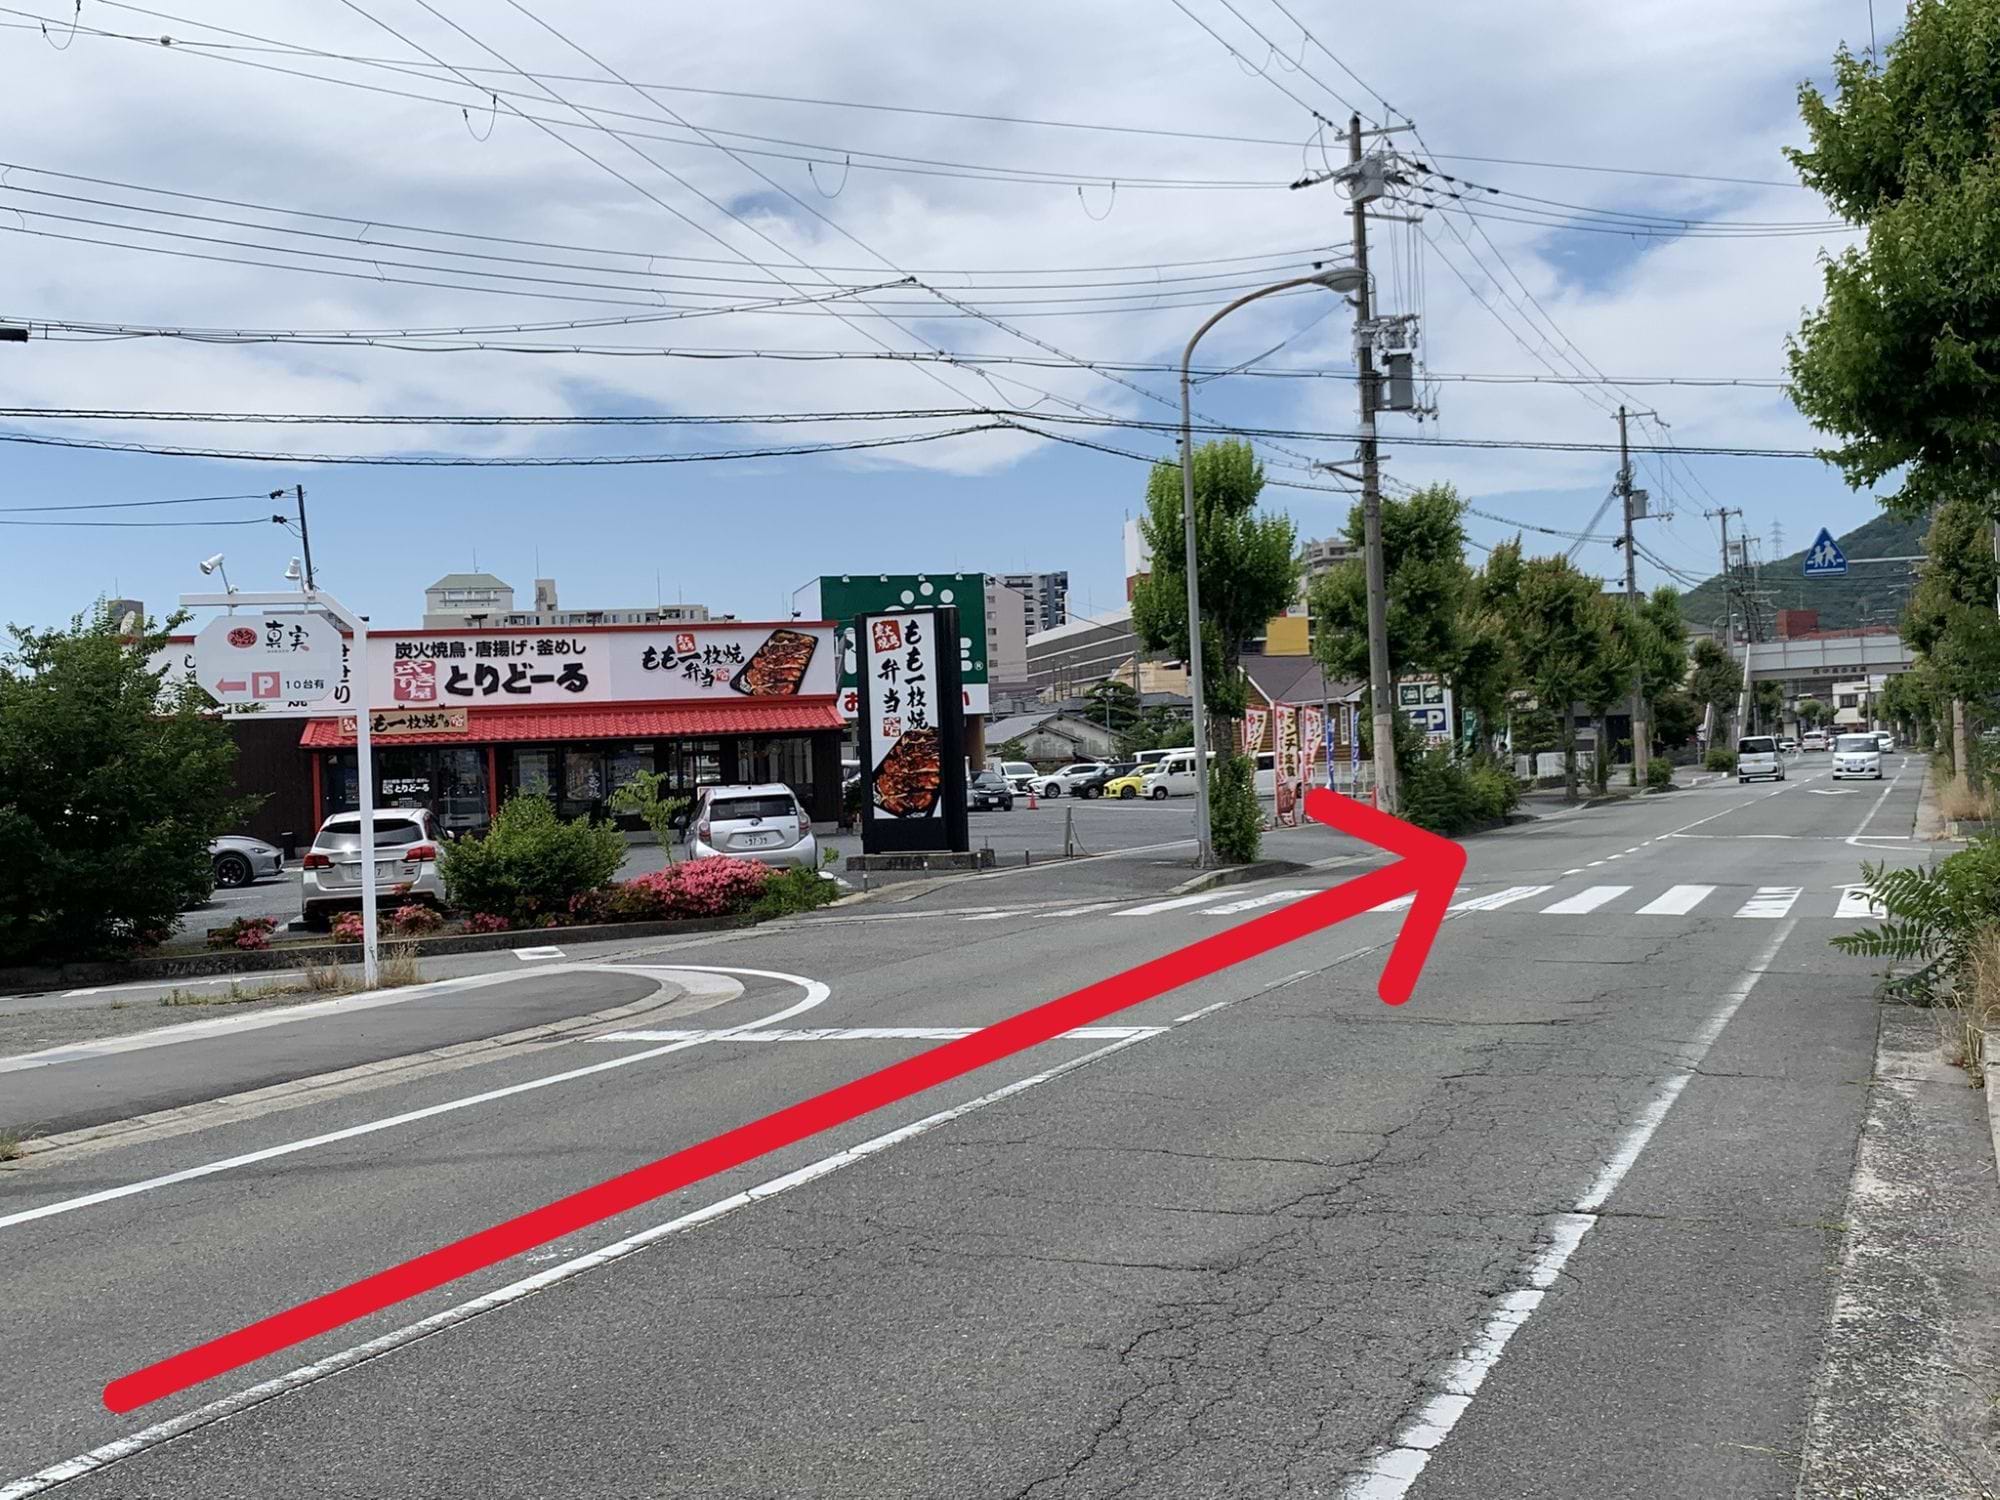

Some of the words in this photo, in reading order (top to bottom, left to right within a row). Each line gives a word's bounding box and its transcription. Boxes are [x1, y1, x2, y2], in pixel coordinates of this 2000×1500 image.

[265, 620, 311, 651] 真実
[642, 643, 745, 670] もも一枚焼
[285, 679, 325, 690] 10台有
[444, 662, 589, 697] とりどーる
[681, 662, 715, 688] 弁当
[877, 658, 901, 714] 弁当
[904, 619, 928, 730] もも一枚焼
[1427, 710, 1444, 730] P
